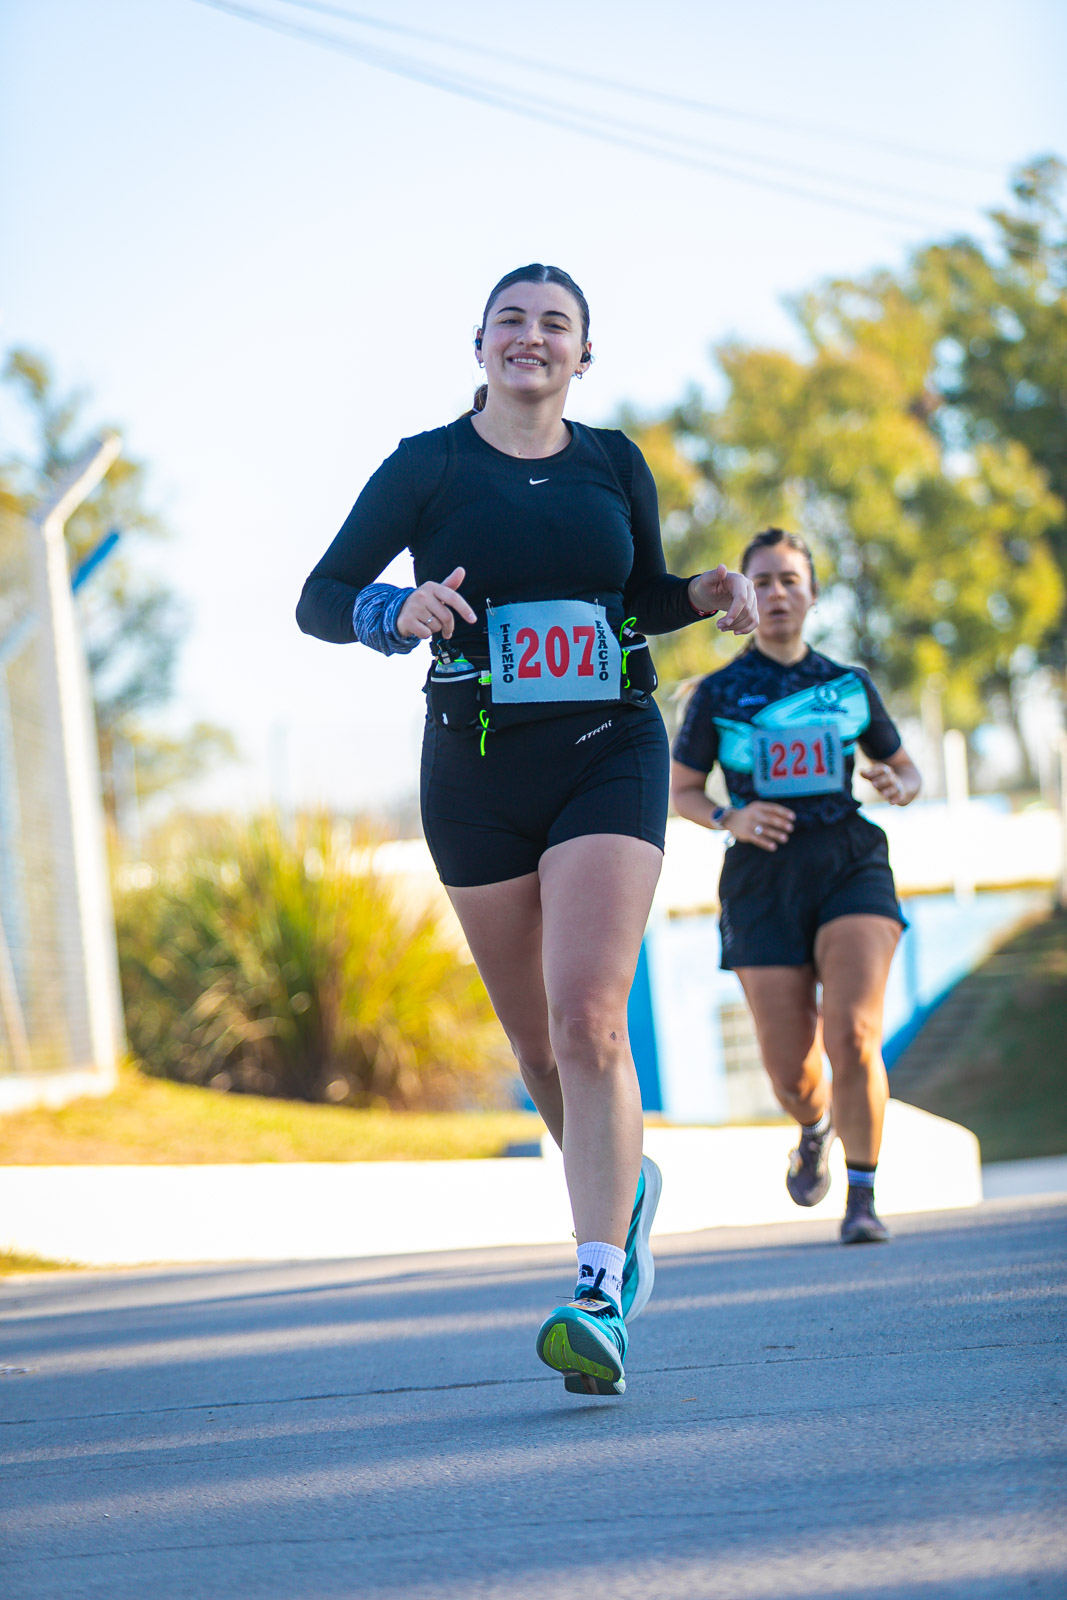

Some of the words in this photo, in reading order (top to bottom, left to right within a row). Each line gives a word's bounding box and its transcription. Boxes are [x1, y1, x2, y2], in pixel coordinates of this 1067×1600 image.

[500, 623, 515, 683] TIEMPO
[515, 625, 596, 679] 207
[595, 620, 609, 681] EXACTO
[769, 738, 827, 779] 221
